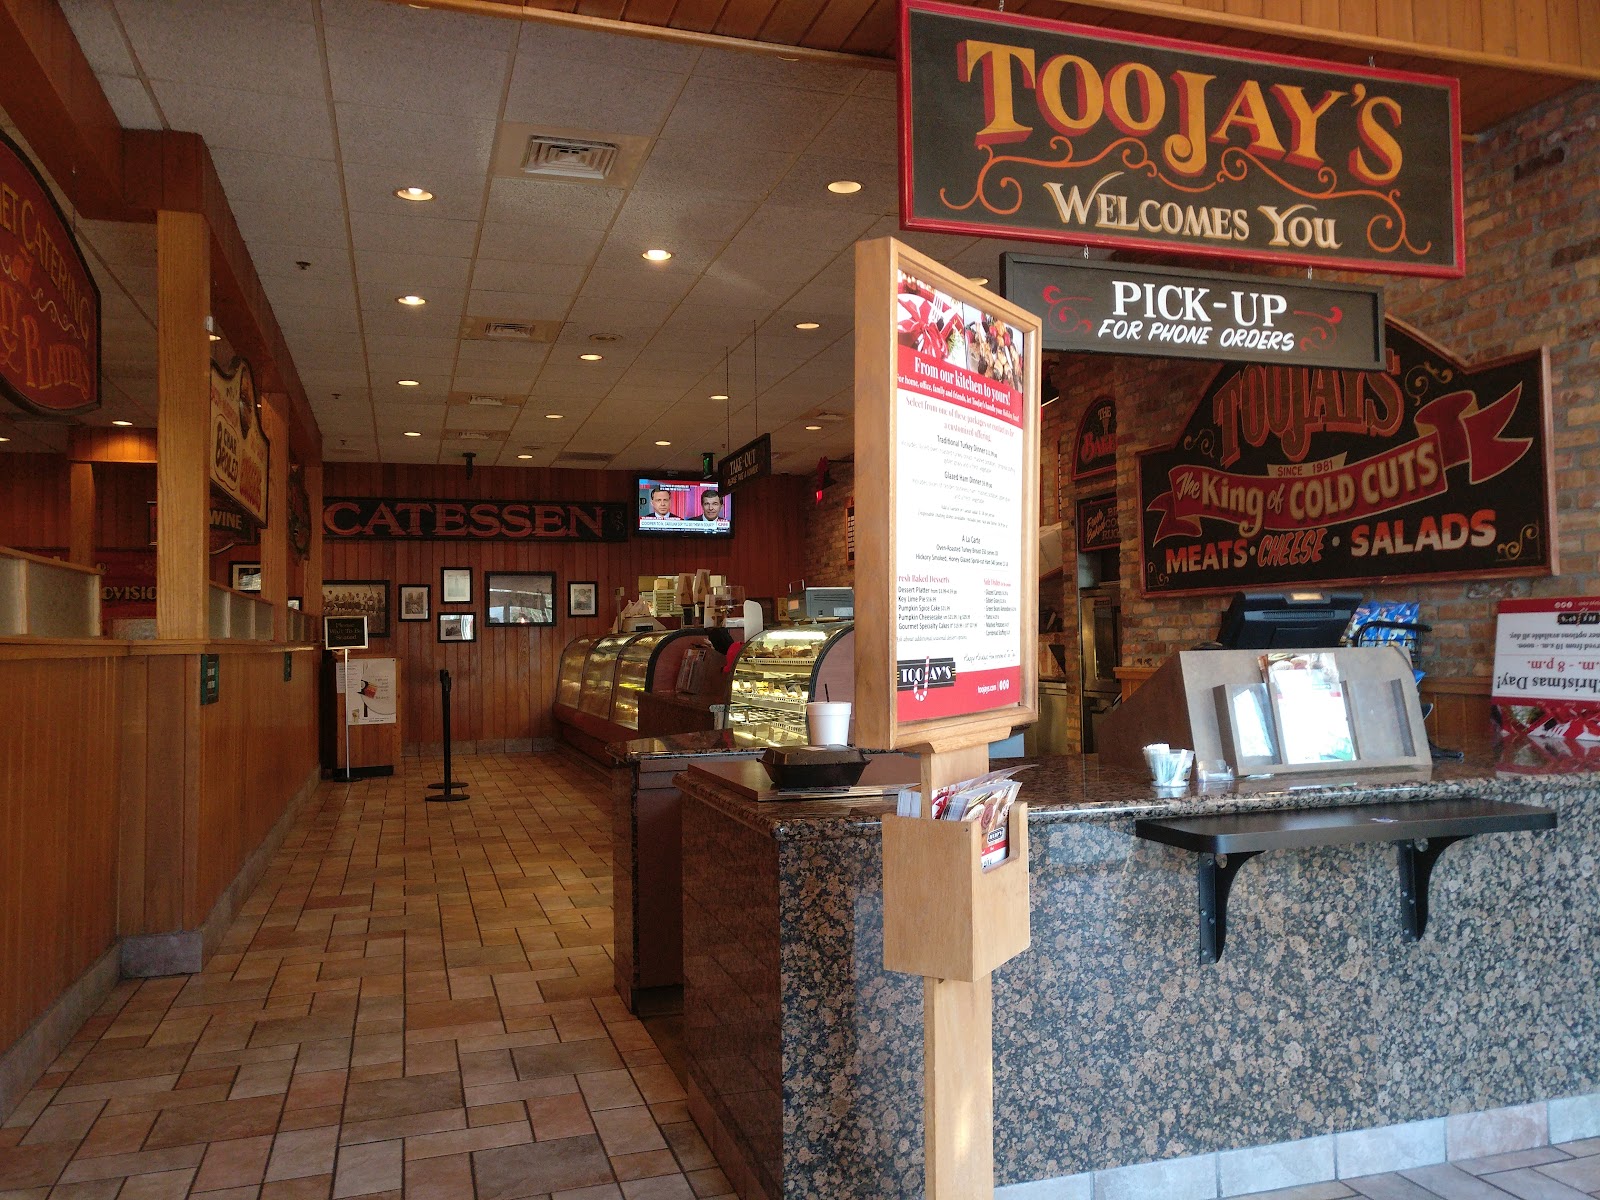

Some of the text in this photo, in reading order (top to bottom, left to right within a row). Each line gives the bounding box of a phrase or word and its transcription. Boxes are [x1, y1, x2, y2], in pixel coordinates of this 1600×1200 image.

[957, 39, 1403, 187] TOOJAY'S
[1043, 172, 1249, 241] WELCOMES
[21, 199, 90, 348] CATERING
[1112, 281, 1288, 328] PICK-UP
[1098, 319, 1295, 352] FOR PHONE ORDERS
[905, 375, 919, 388] home,
[914, 356, 1010, 406] From our kitchen to yours!
[906, 396, 924, 409] Select
[924, 401, 938, 412] from
[1098, 406, 1112, 420] THE
[937, 435, 960, 448] Traditional
[960, 440, 973, 452] Turkey
[1277, 460, 1334, 476] SINCE 1981
[1175, 442, 1440, 537] The King of COLD CUTS
[211, 510, 242, 530] WINE
[323, 502, 603, 538] CATESSEN
[971, 536, 980, 544] Carte
[1257, 529, 1325, 567] CHEESE
[1351, 509, 1497, 557] SALADS
[916, 554, 931, 562] Hickory
[898, 574, 910, 582] resh
[912, 574, 928, 583] Baked
[1528, 657, 1555, 669] p.m.
[1558, 662, 1566, 672] 8
[901, 656, 952, 702] TOOJAY'S
[1497, 672, 1528, 690] Day!
